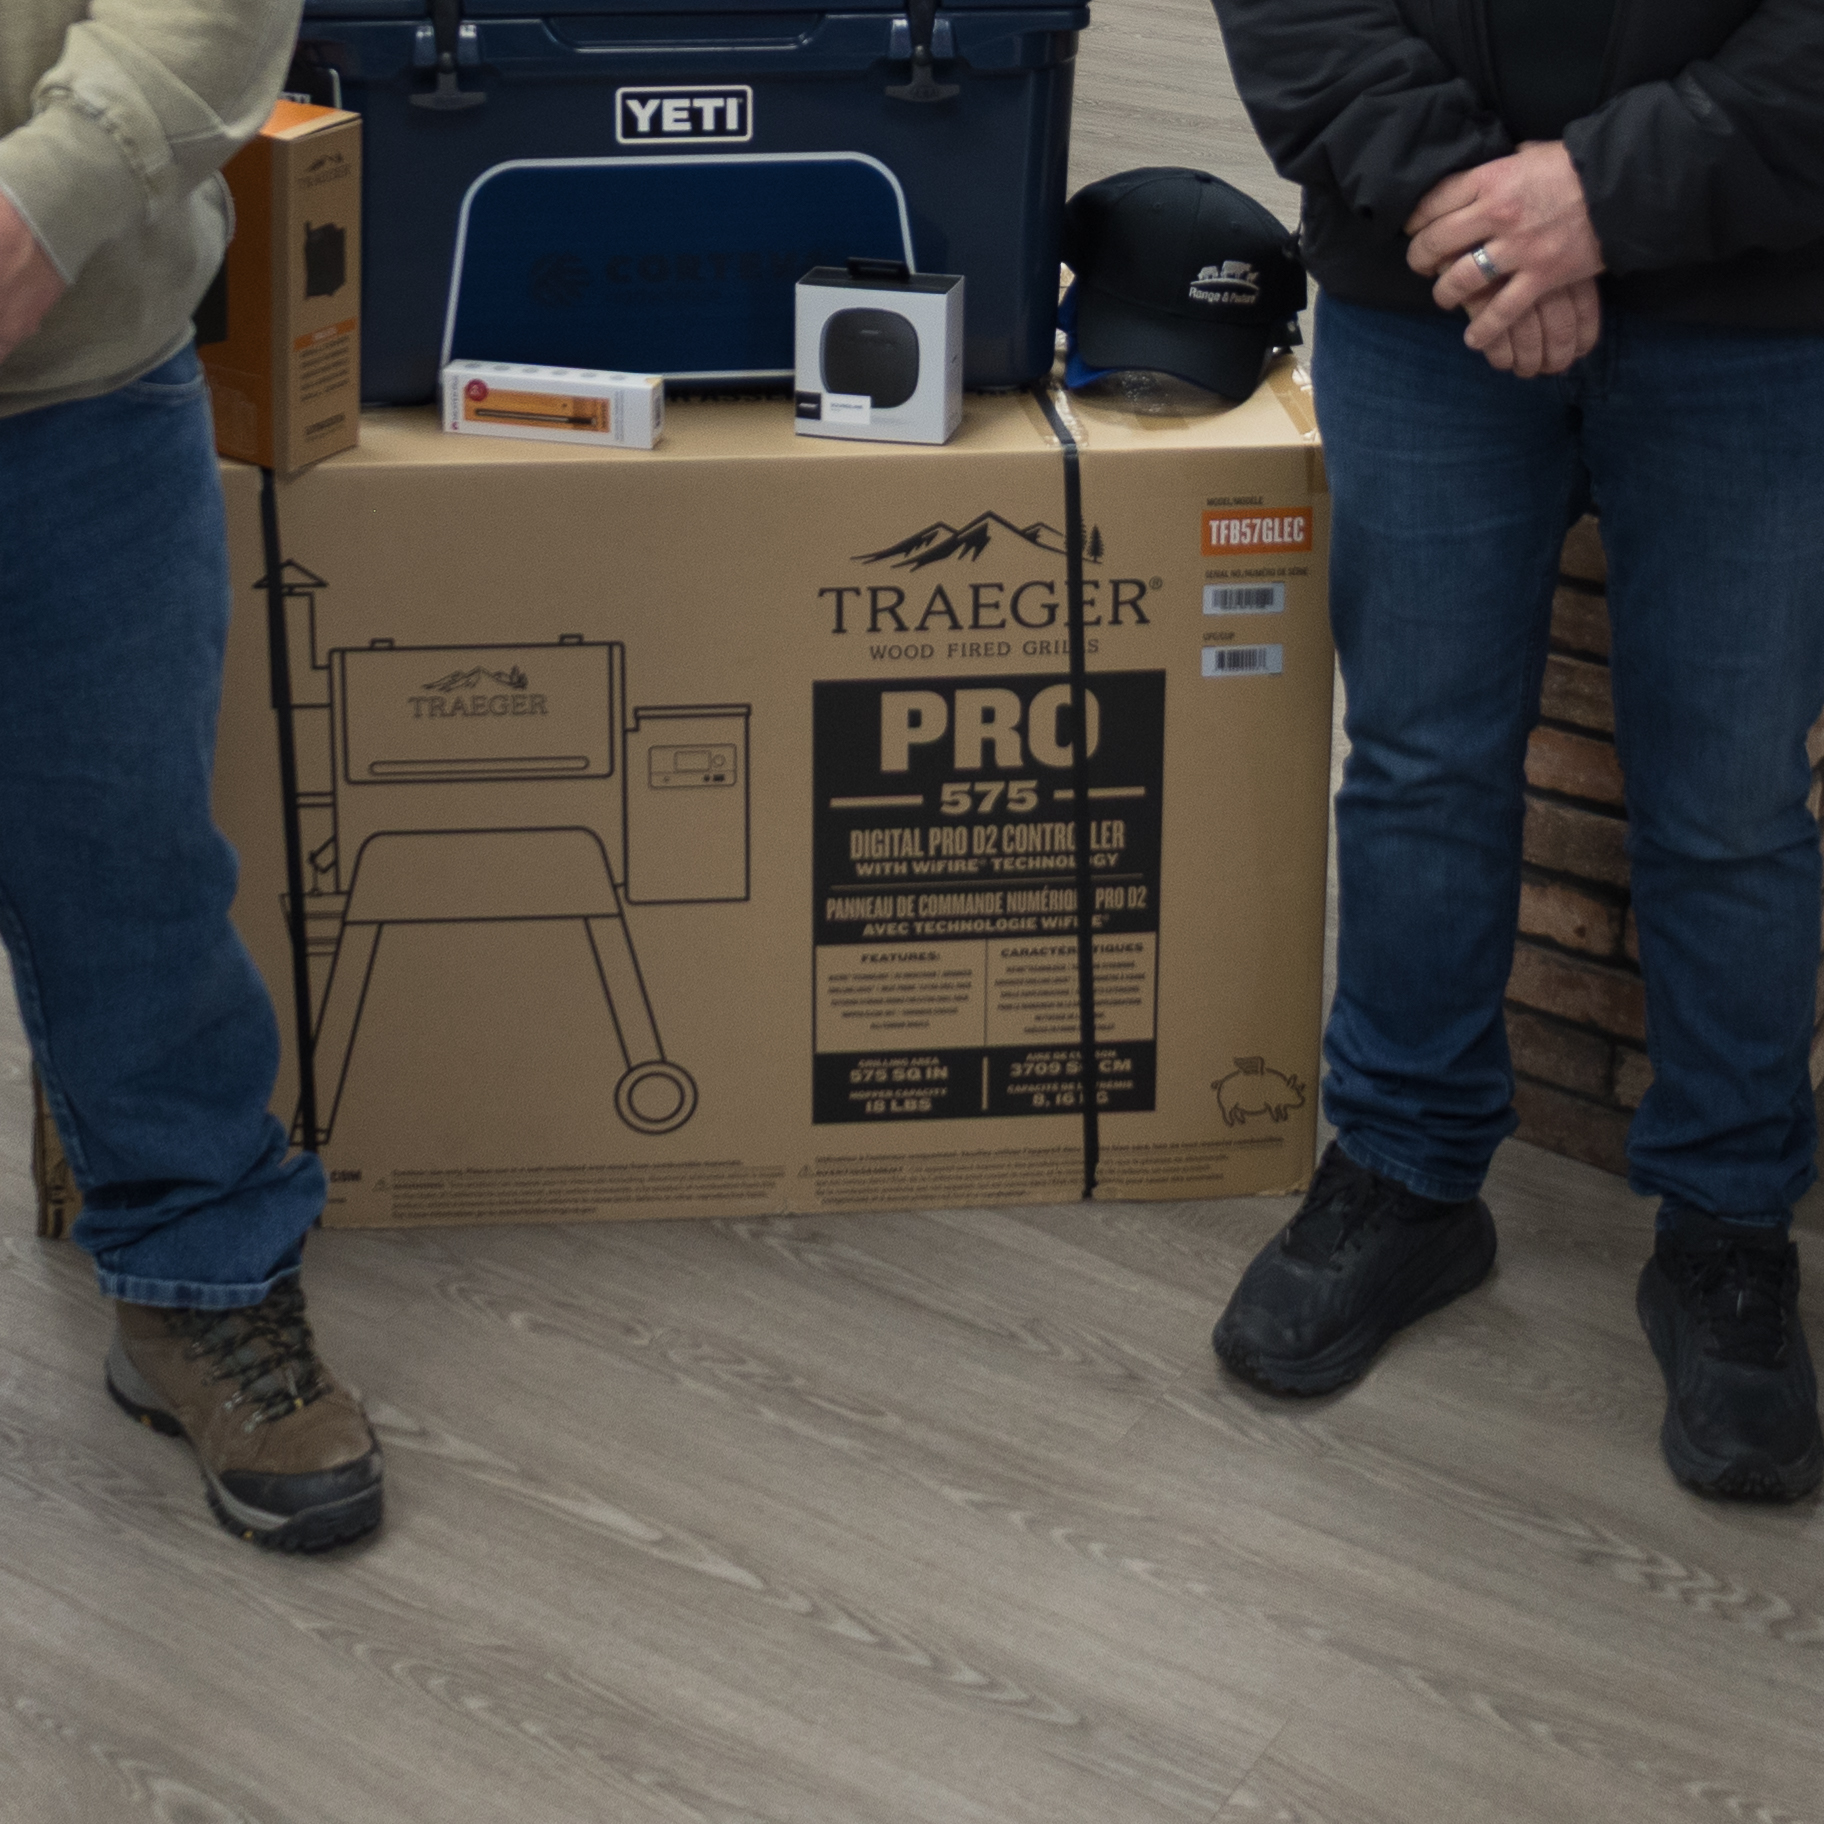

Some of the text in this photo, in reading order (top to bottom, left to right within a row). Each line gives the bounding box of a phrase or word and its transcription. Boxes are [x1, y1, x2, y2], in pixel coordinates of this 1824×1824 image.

[626, 97, 739, 133] YETI
[1209, 516, 1305, 546] TFB57GLEC
[818, 578, 1151, 634] TRAEGER
[869, 639, 1100, 661] WOOD FIRED GRILS
[407, 693, 549, 719] TRAEGER
[880, 683, 1100, 772] PRO
[939, 779, 1039, 816] 575
[849, 820, 1125, 860] DIGITAL PRO D2 CONTROLER
[855, 861, 909, 876] WITH
[991, 853, 1119, 871] TECHNOLGY
[826, 896, 893, 921] PANNEAU
[896, 894, 916, 918] DE
[918, 892, 1004, 916] COMMANDE
[1095, 887, 1125, 909] PRO
[1127, 885, 1148, 908] D2
[862, 922, 911, 937] AVEC
[914, 917, 1038, 935] TECHNOLOGIE
[849, 1068, 888, 1083] 575
[926, 1066, 949, 1080] IN
[1010, 1061, 1062, 1077] 3709
